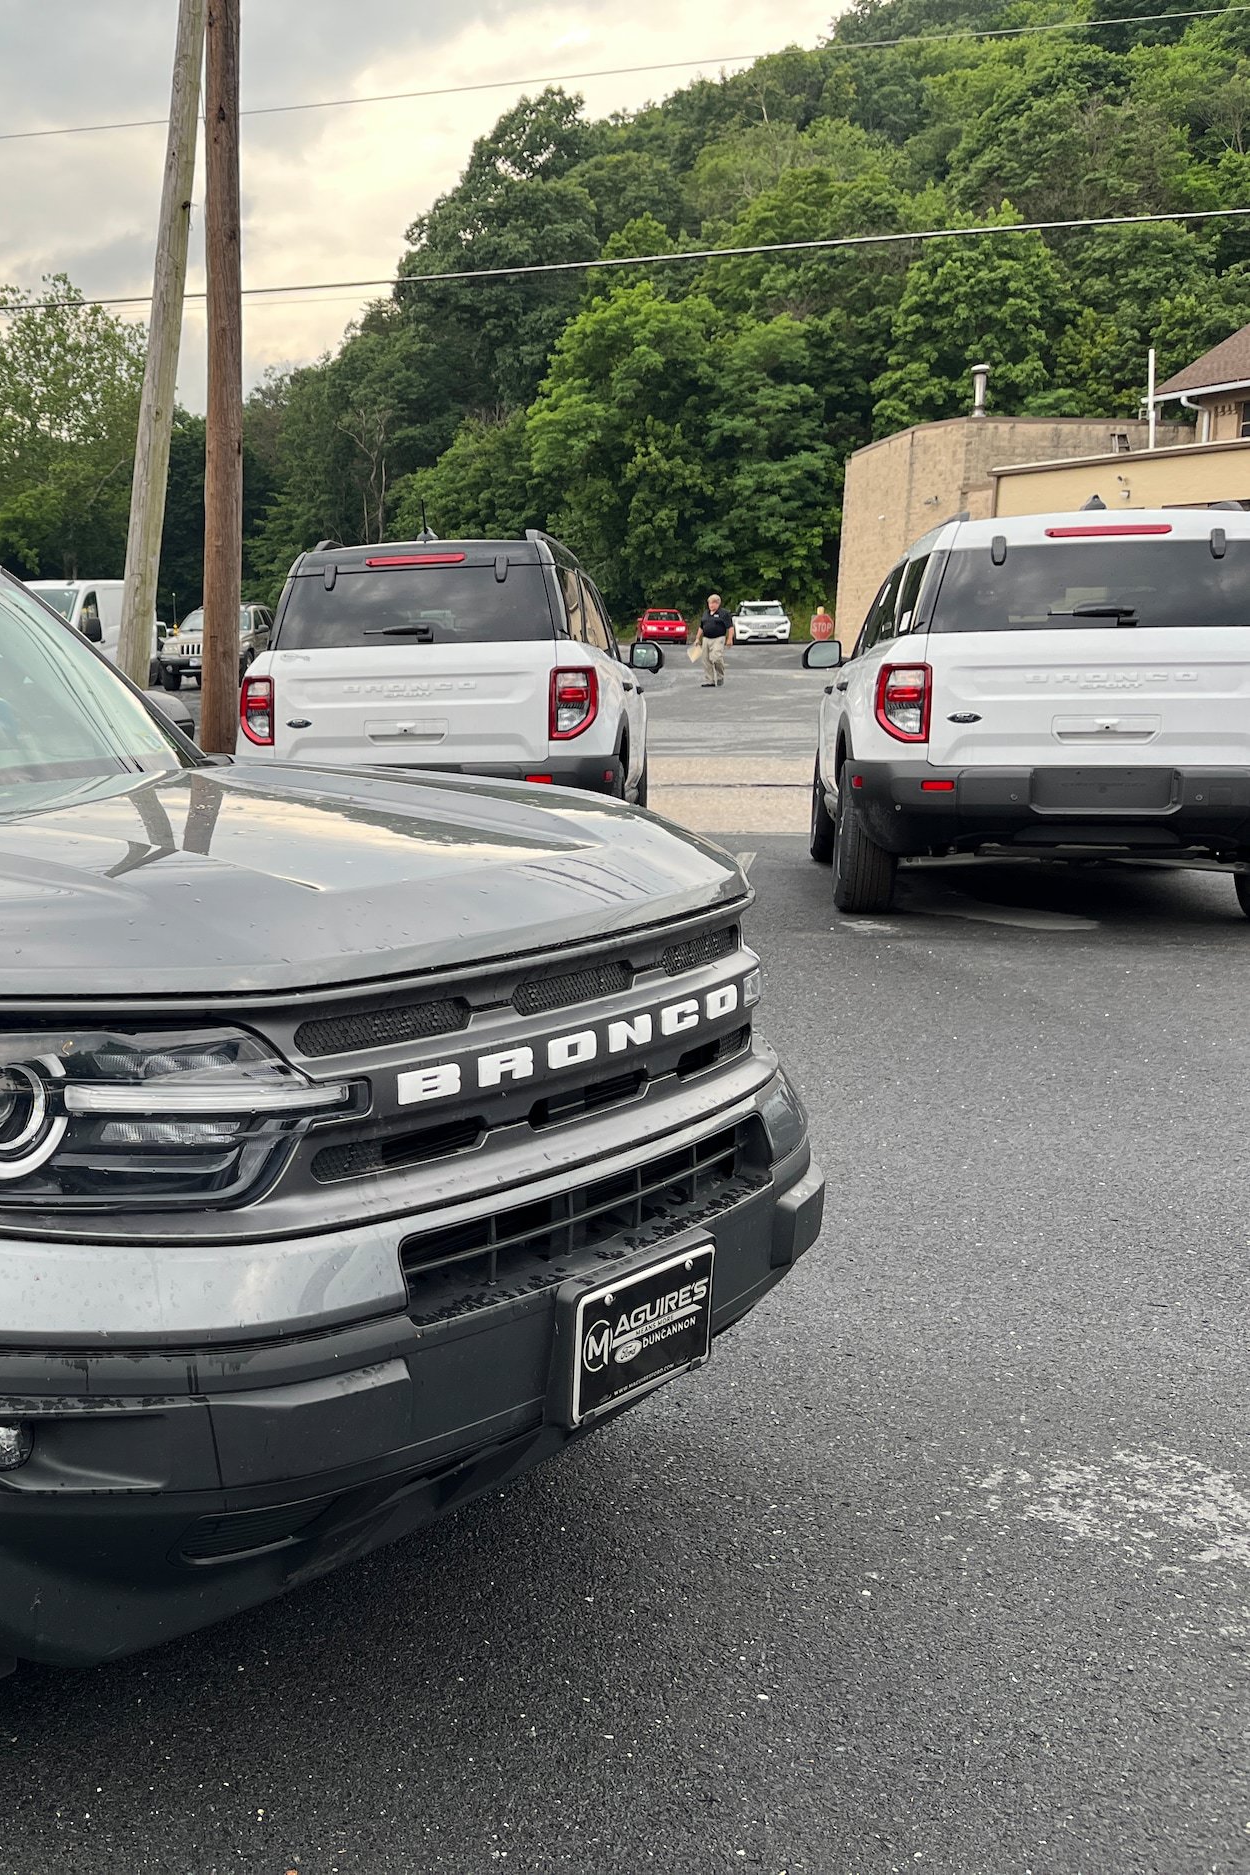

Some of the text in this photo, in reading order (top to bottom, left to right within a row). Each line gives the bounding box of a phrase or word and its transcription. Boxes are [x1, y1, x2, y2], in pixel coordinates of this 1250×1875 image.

[812, 622, 832, 633] STOP
[1024, 671, 1198, 684] BRONCO
[342, 681, 477, 693] BRONCO
[397, 983, 738, 1106] BRONCO
[635, 1315, 674, 1337] MEANS MORE
[642, 1316, 697, 1349] DUNCANNON
